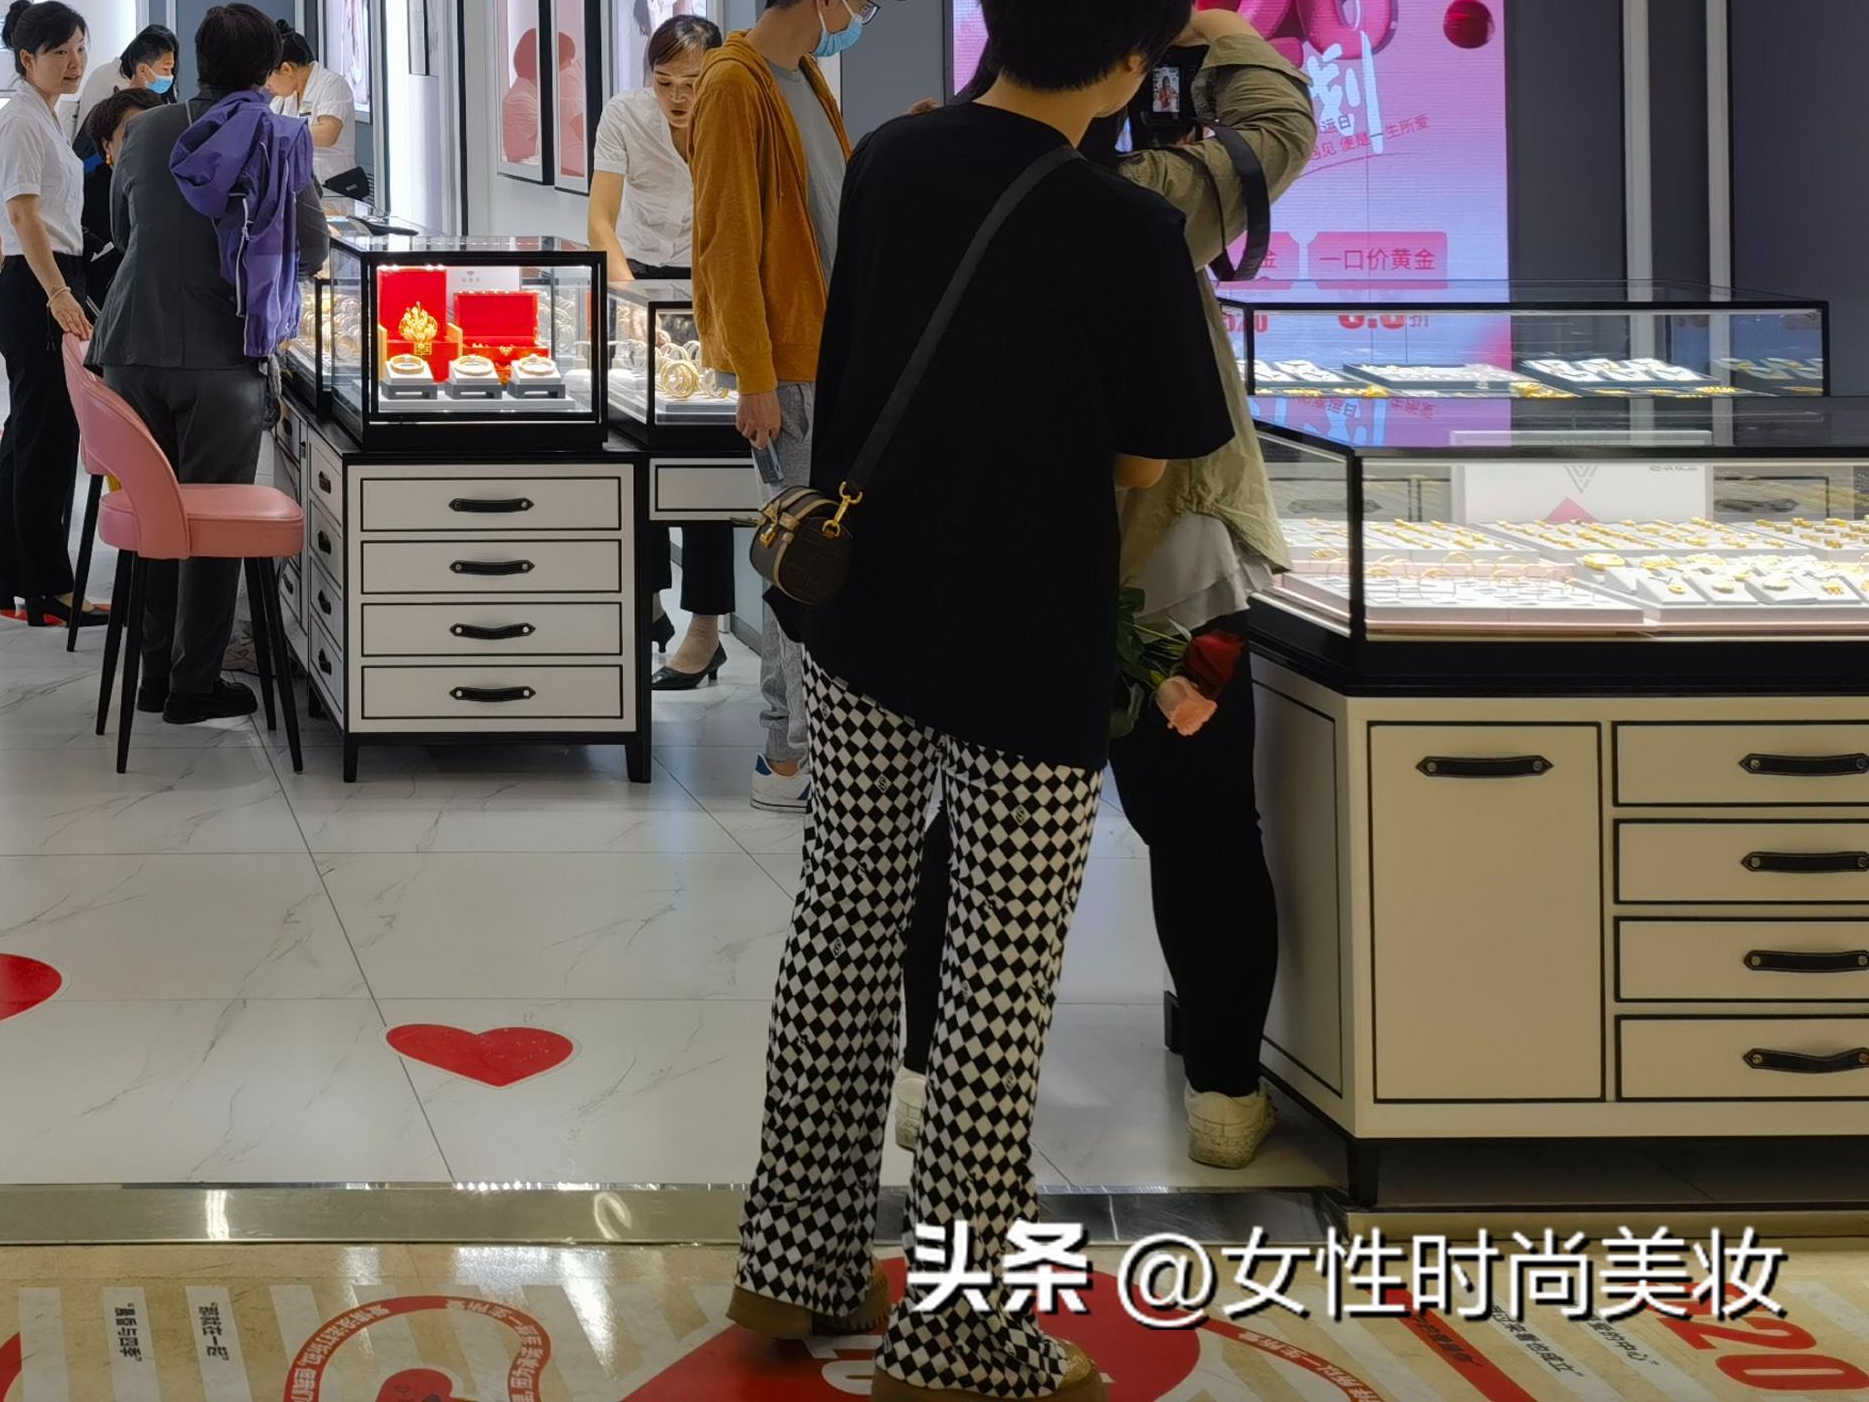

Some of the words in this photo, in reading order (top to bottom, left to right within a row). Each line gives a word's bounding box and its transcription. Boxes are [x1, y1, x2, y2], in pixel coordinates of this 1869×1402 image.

[1319, 114, 1352, 134] 运日
[1319, 248, 1436, 271] 一口价黄金
